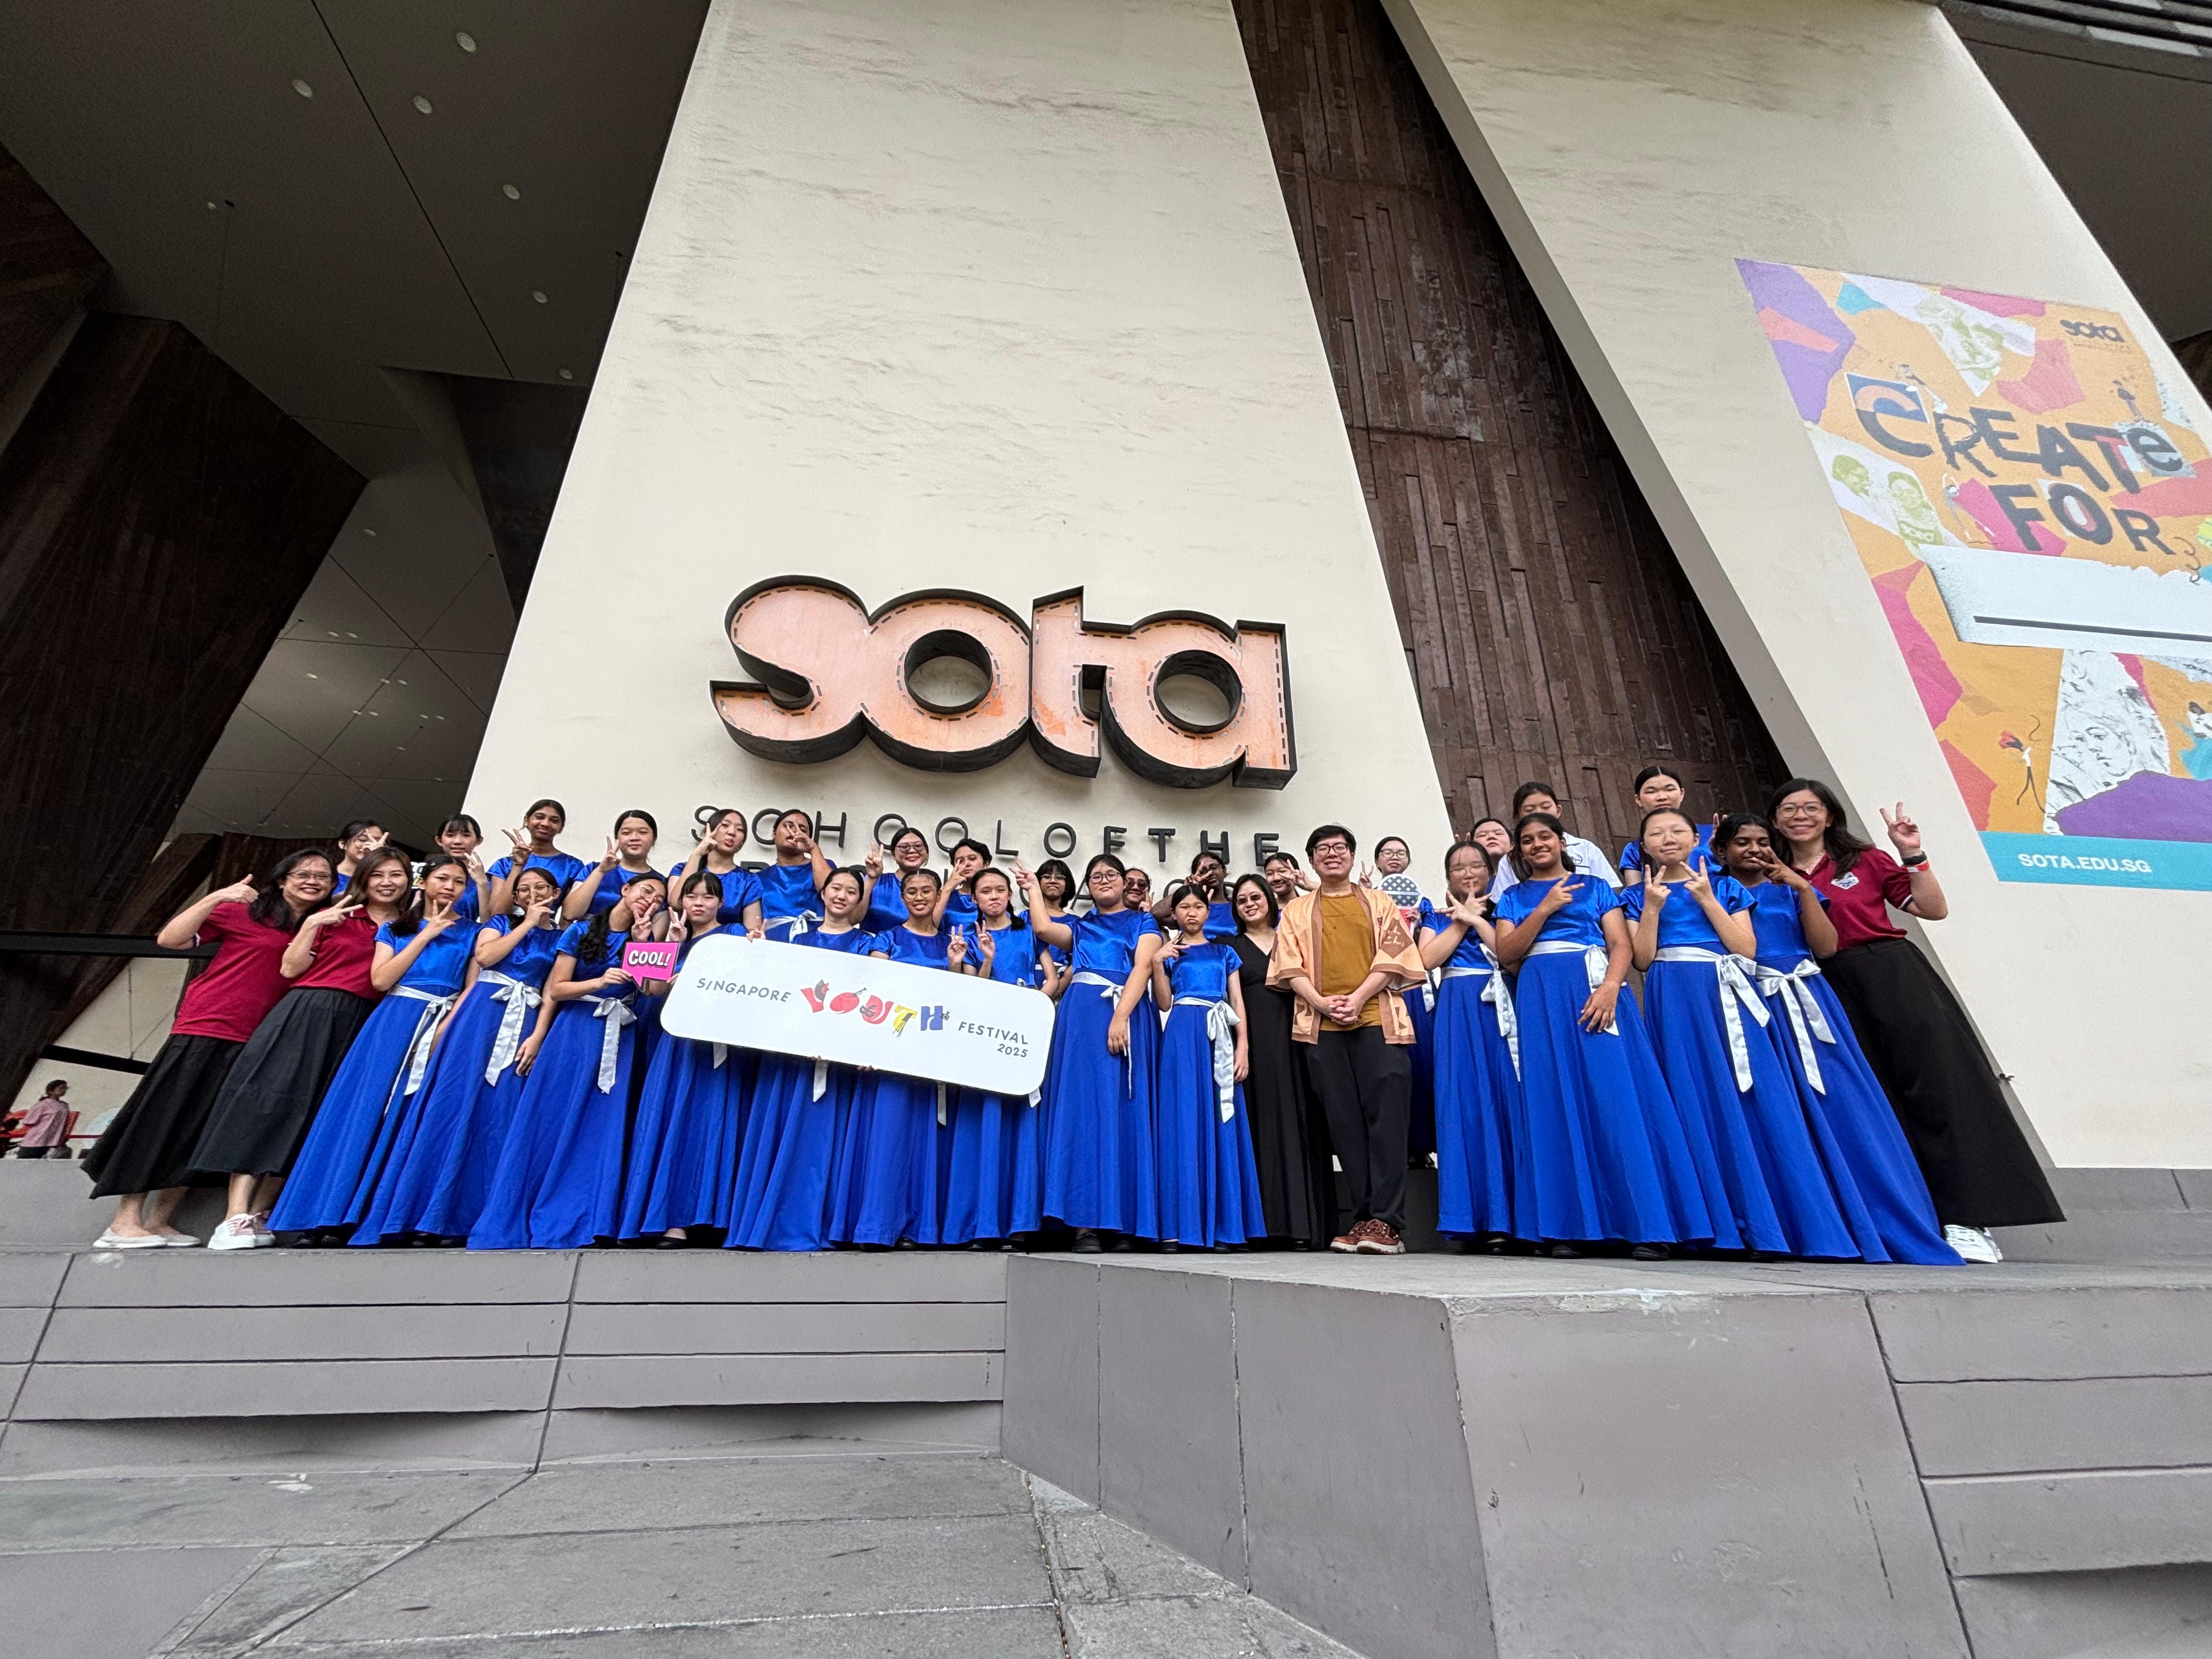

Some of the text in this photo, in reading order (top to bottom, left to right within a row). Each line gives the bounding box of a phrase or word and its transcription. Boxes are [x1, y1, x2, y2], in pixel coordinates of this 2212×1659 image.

[2059, 319, 2125, 342] sota
[1989, 481, 2176, 555] FOR
[709, 574, 1297, 791] sota
[2018, 853, 2152, 873] SOTA.EDU.SG
[628, 950, 672, 967] COOL!
[696, 978, 1029, 1045] SINGAPORE YOUTH FESTIVAL
[997, 1043, 1029, 1058] 2025
